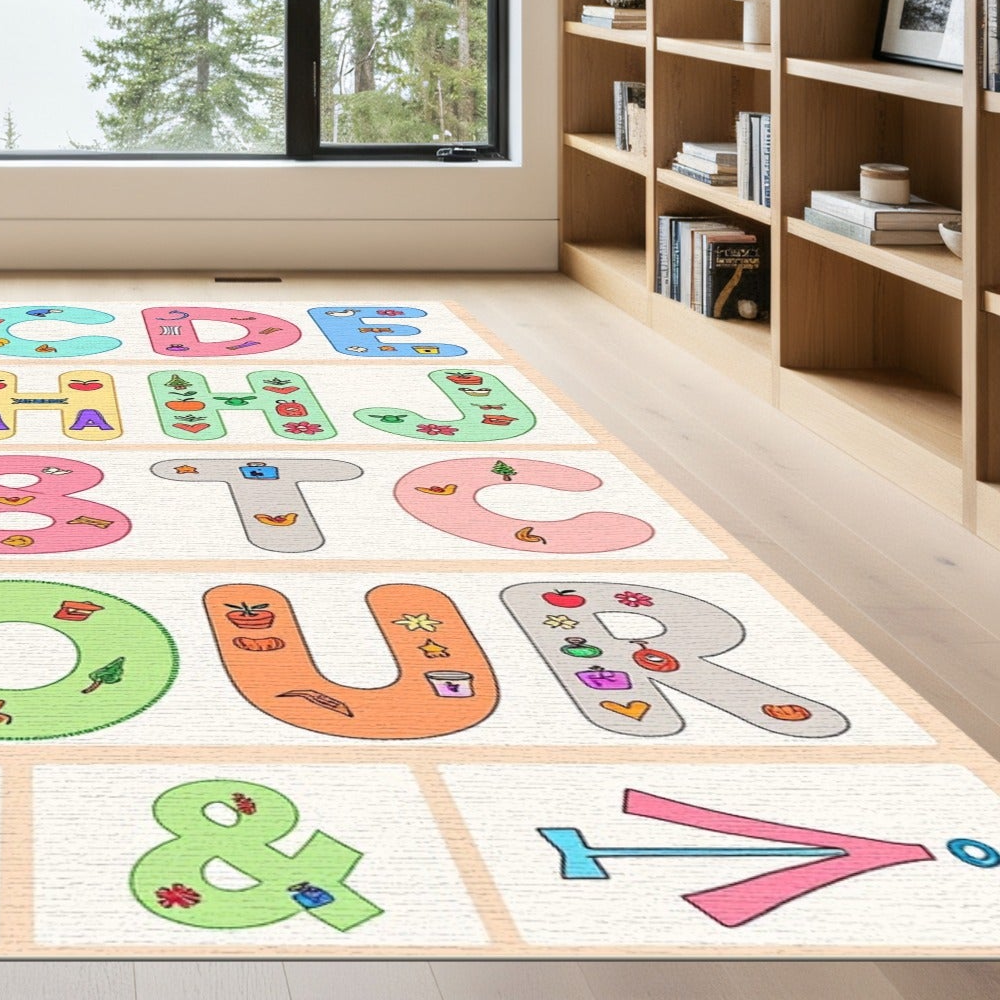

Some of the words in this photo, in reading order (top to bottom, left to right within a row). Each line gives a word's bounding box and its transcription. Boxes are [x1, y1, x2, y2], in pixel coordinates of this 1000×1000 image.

[141, 306, 302, 358] D
[307, 306, 468, 358] E
[69, 409, 114, 430] A
[147, 370, 337, 442] H
[353, 369, 536, 442] J
[150, 458, 364, 553] T
[393, 456, 655, 554] C
[202, 583, 499, 740] U
[499, 581, 850, 738] R
[129, 779, 384, 932] &
